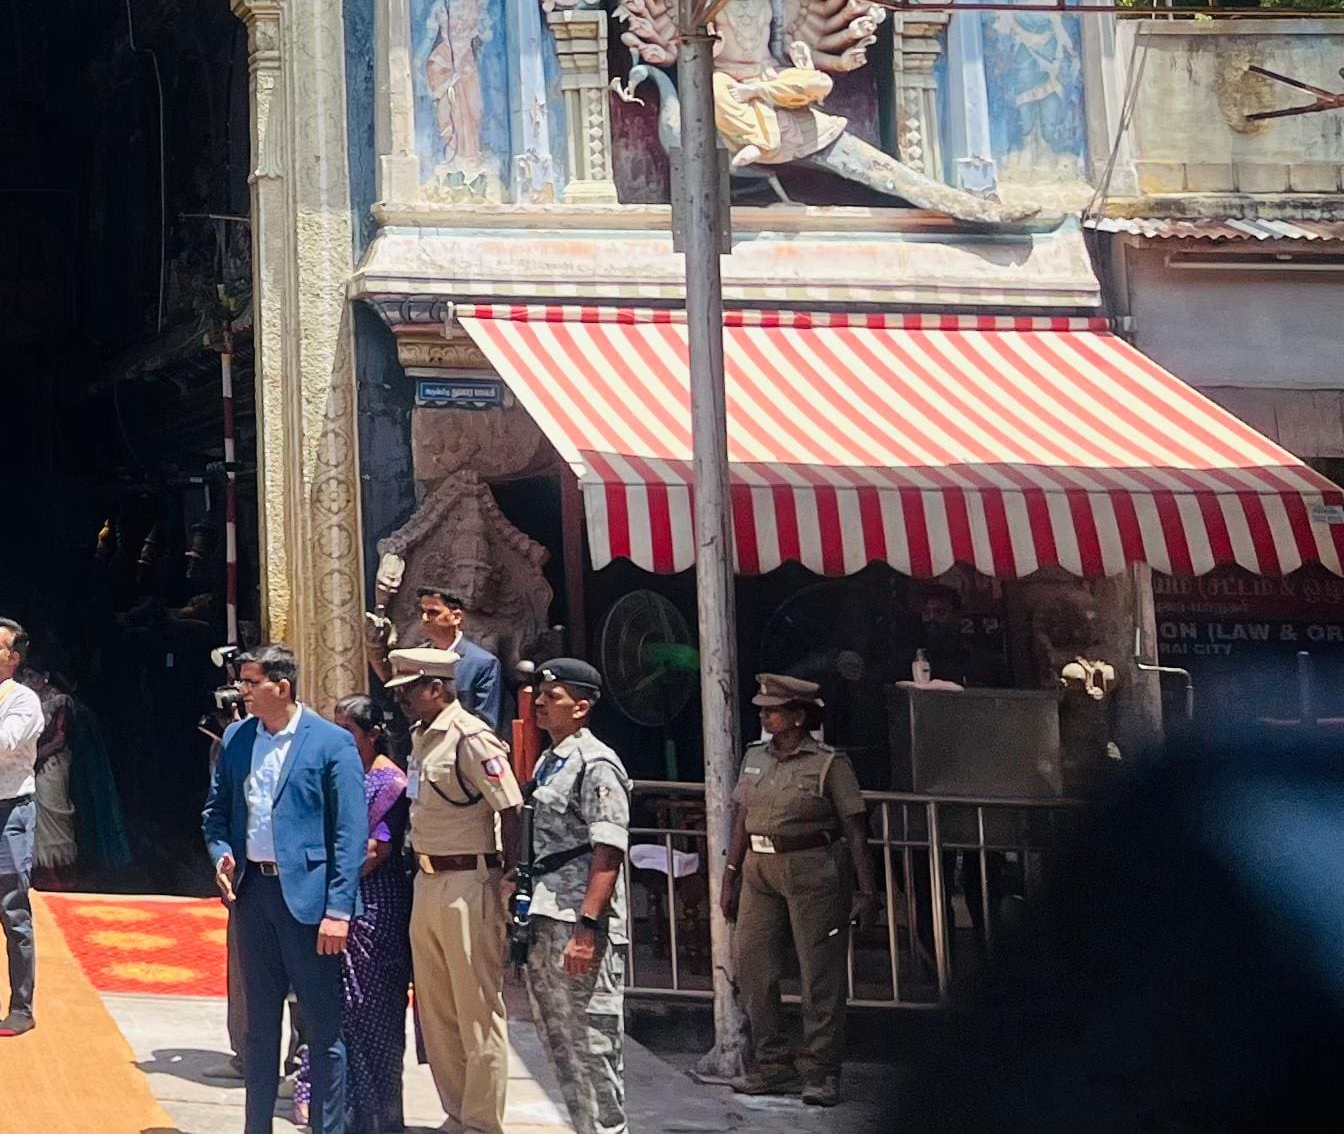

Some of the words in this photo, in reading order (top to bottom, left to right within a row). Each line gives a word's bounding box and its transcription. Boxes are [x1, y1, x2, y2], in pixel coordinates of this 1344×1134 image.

[1160, 622, 1198, 641] ON
[1207, 623, 1271, 643] (LAW
[1280, 624, 1298, 641] &
[1306, 624, 1344, 642] OR
[1194, 643, 1233, 656] CITY
